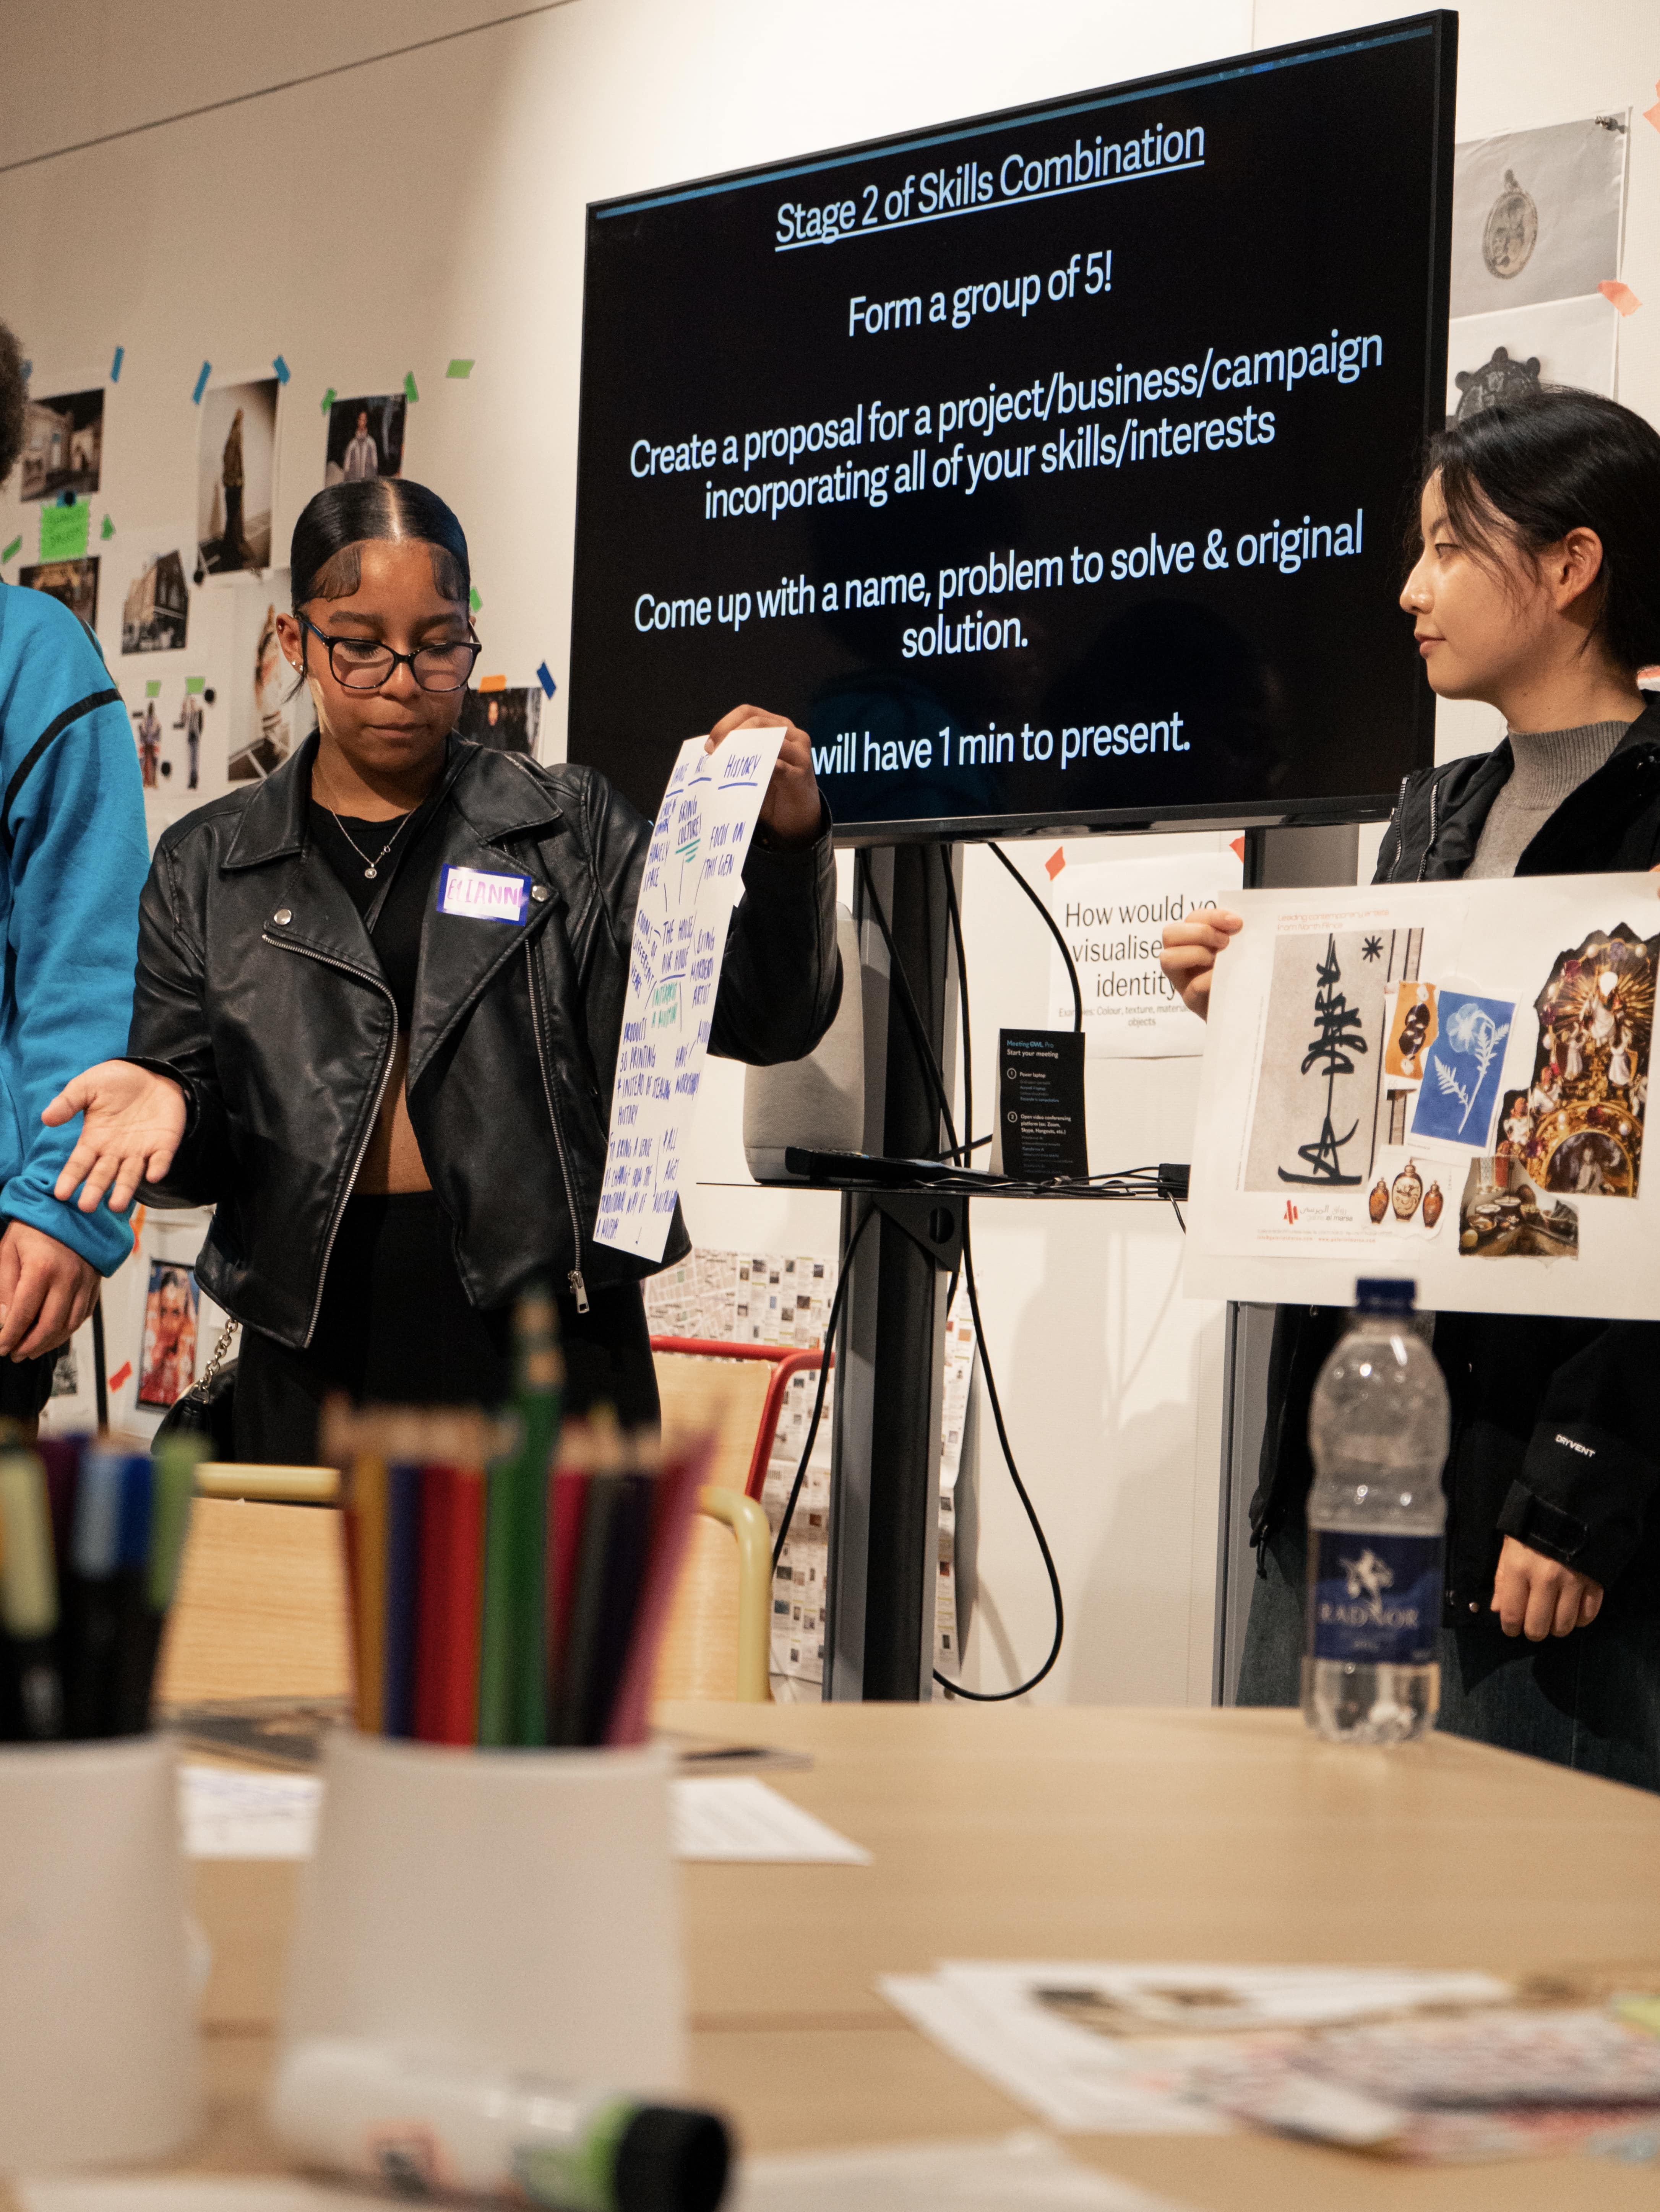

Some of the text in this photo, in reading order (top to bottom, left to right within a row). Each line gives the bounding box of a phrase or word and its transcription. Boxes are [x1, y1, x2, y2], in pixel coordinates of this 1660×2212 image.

[776, 123, 1204, 244] Stage 2 of Skills Combination
[849, 250, 1112, 337] Form a group of 5!
[630, 329, 1382, 477] Create a proposal for a project/business/campaign
[706, 405, 1275, 520] incorporating all of your skills/interests
[634, 508, 1363, 632] Come up with a name, problem to solve & original
[902, 610, 1028, 658] solution.
[811, 712, 1190, 775] will have 1 min to present.
[709, 821, 746, 851] FOCUS ON
[662, 919, 675, 947] THE
[1066, 902, 1113, 927] How
[1119, 894, 1184, 924] would
[1073, 934, 1162, 962] visualise
[1096, 971, 1175, 1000] identity
[1555, 1434, 1596, 1458] DRYVENT
